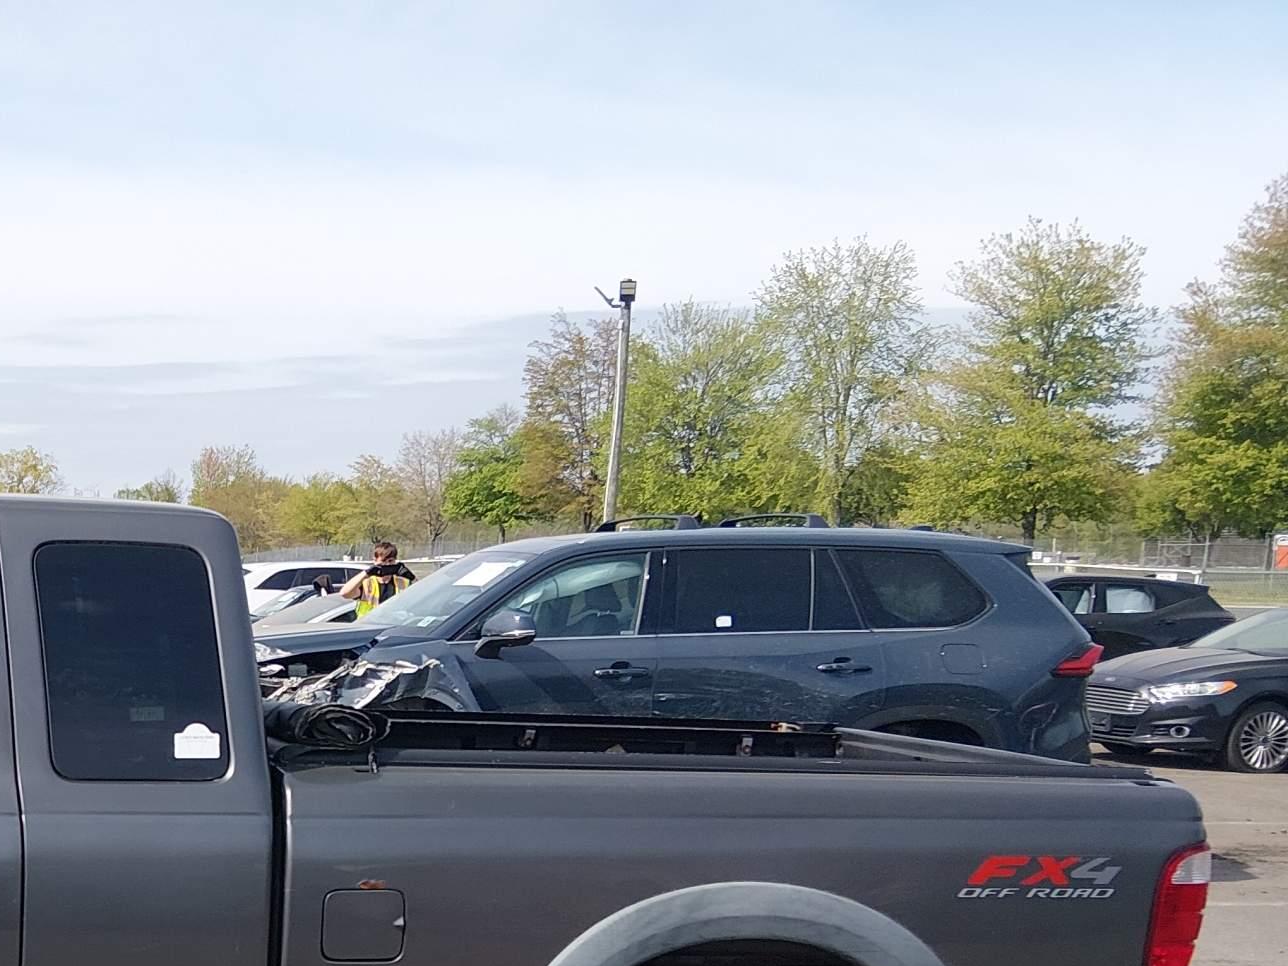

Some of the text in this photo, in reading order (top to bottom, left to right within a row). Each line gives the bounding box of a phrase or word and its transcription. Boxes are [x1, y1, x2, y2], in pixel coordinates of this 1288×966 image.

[967, 854, 1122, 886] FX4
[957, 887, 1115, 898] OFF ROAD
